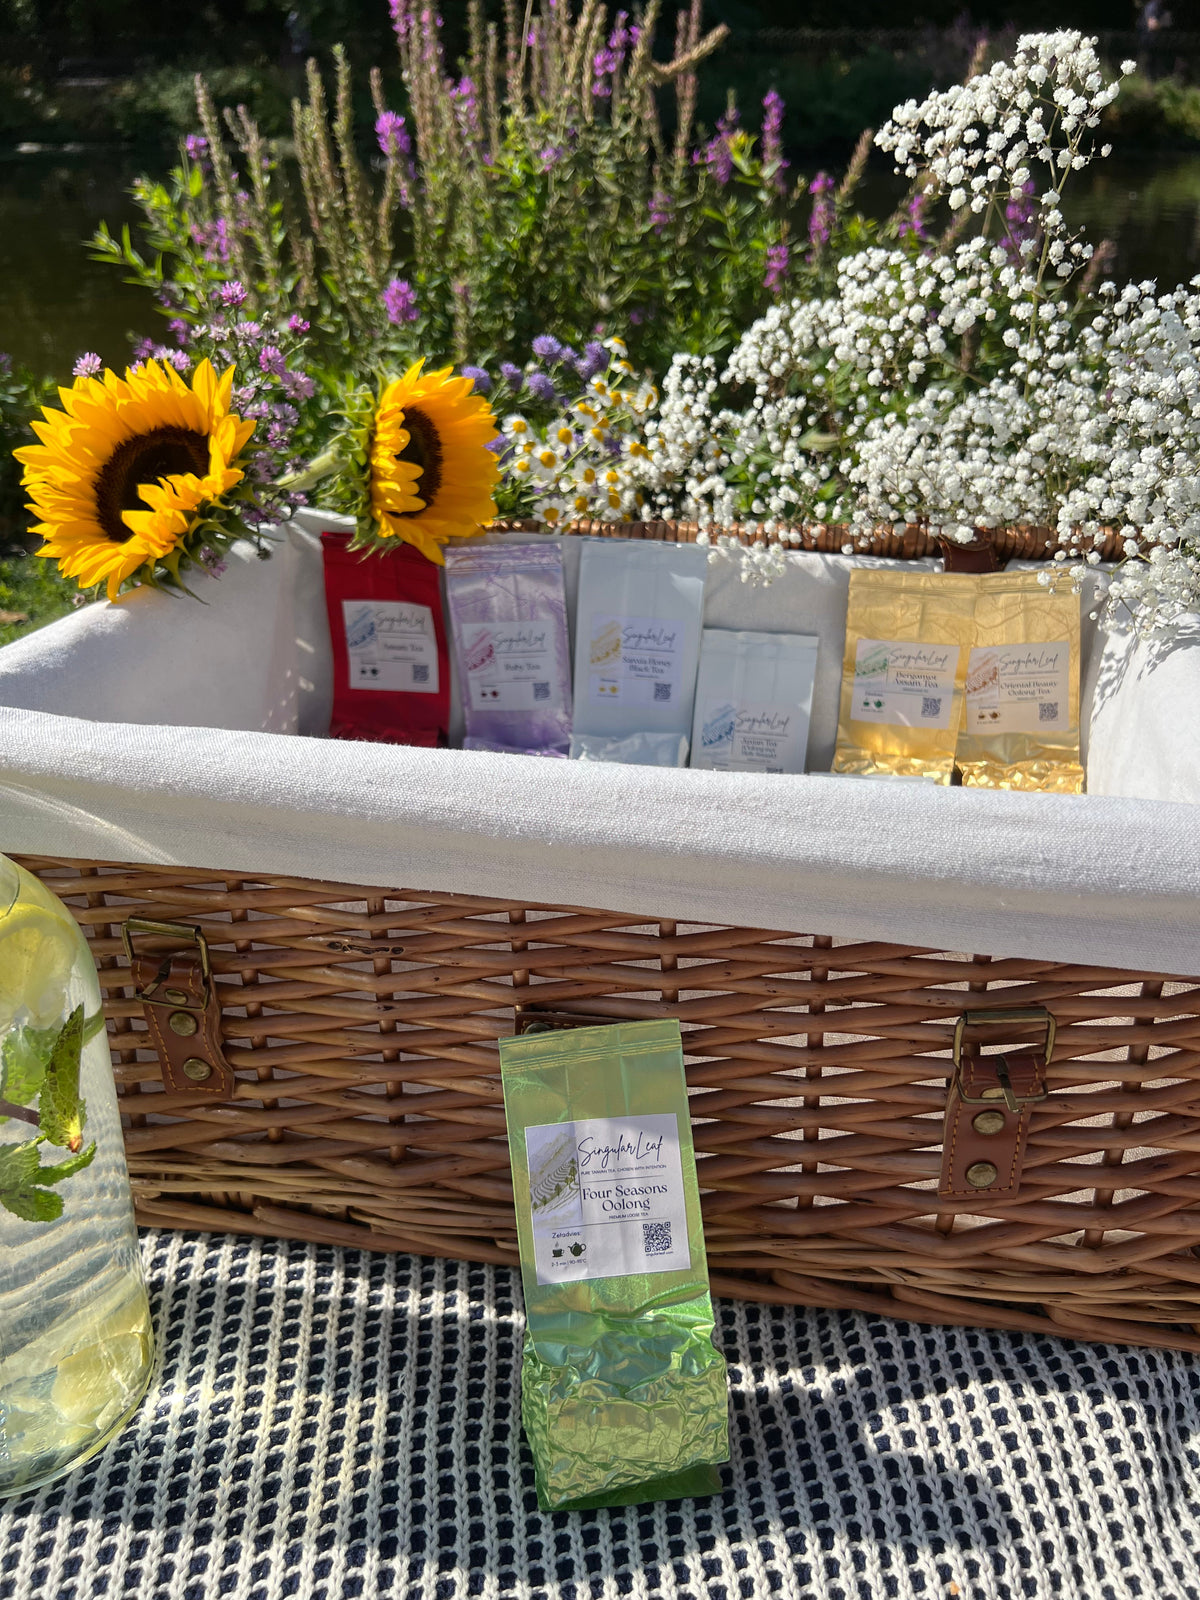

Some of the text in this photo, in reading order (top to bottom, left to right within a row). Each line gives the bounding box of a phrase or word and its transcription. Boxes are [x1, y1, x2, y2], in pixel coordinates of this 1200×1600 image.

[651, 666, 665, 674] Tea
[924, 680, 938, 688] Tea
[1000, 680, 1057, 690] Oriental Beauty
[1007, 688, 1036, 697] Oolong
[582, 1184, 668, 1200] Four Seasons
[602, 1197, 651, 1211] Oolong
